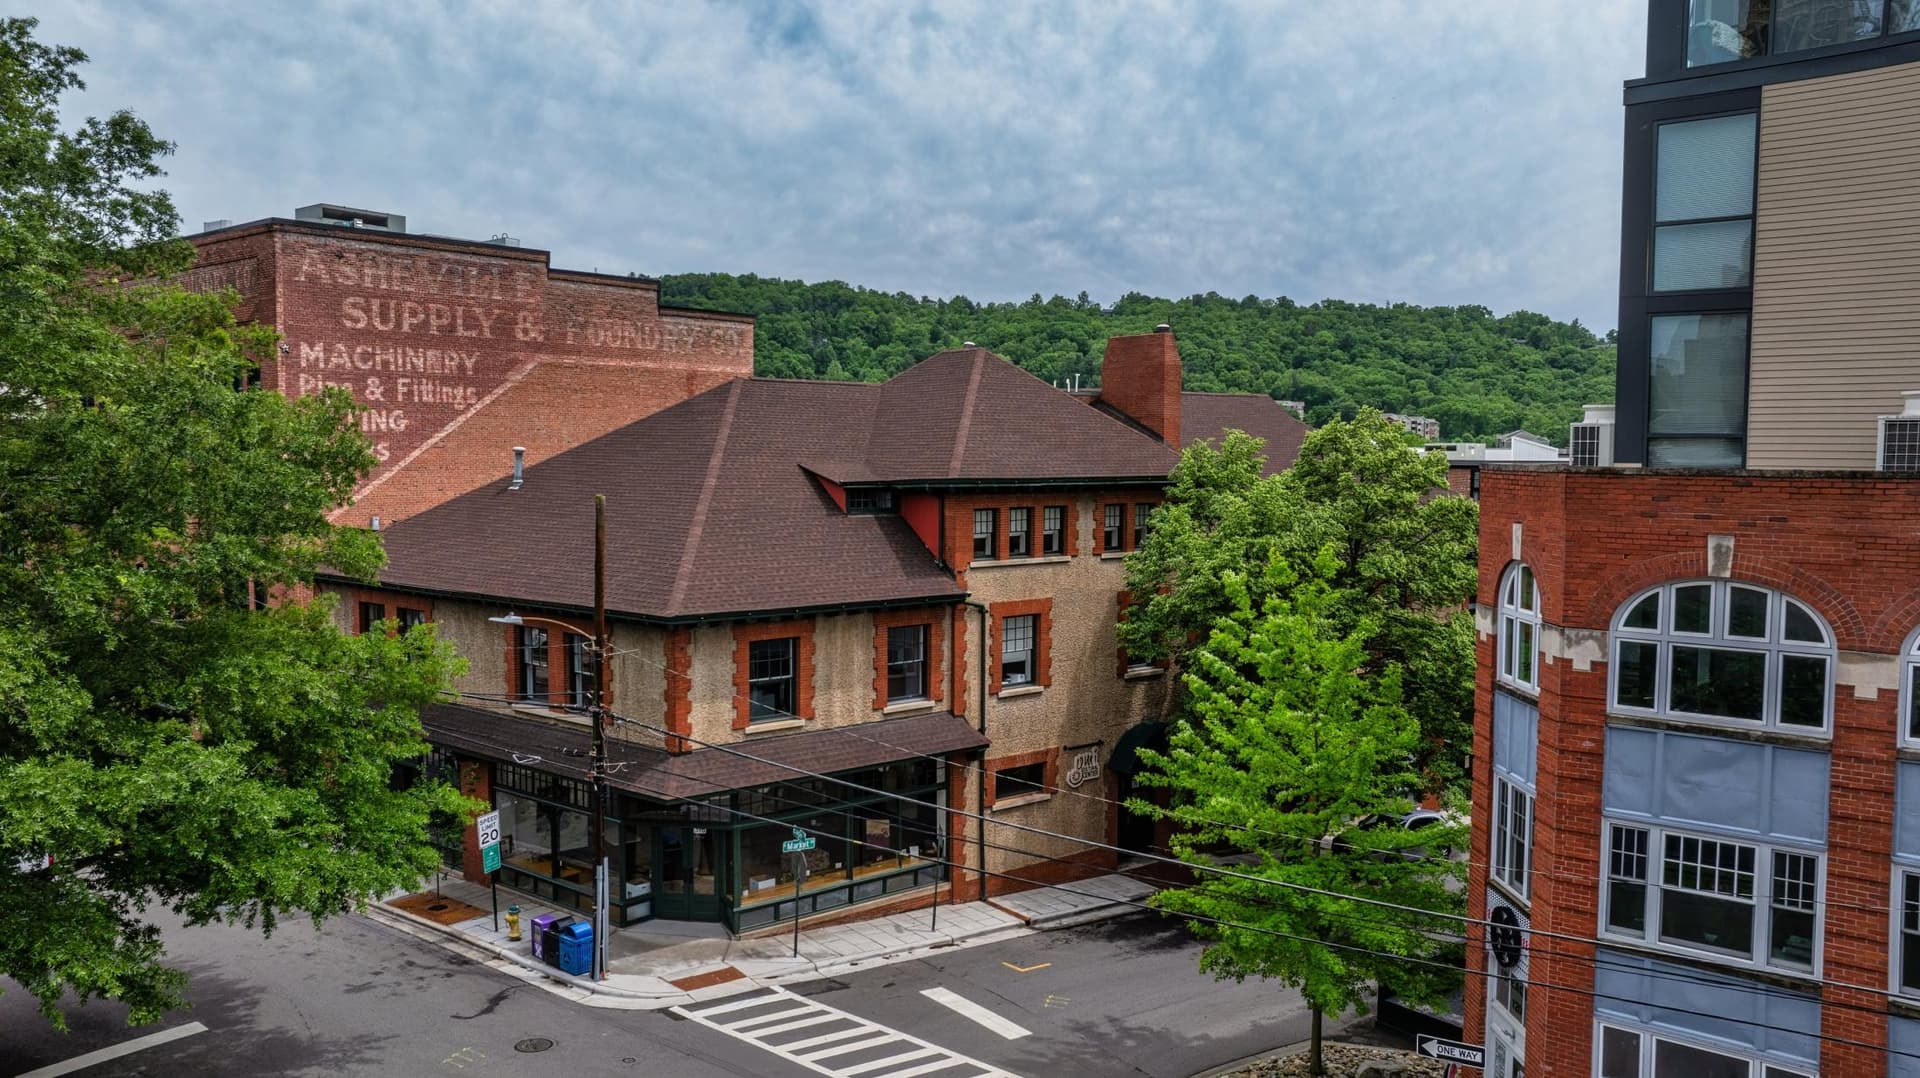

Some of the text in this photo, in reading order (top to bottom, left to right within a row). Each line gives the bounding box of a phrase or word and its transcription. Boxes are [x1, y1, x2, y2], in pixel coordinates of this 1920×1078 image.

[341, 296, 498, 339] SUPPLY
[514, 310, 544, 342] &
[299, 341, 480, 376] MACHINERY
[364, 376, 384, 402] &
[396, 376, 478, 411] Fittings
[480, 815, 497, 825] SPEED
[481, 822, 496, 831] LIMIT
[480, 829, 498, 844] 20
[787, 842, 806, 850] Market
[1437, 1046, 1478, 1059] ONE WAY
